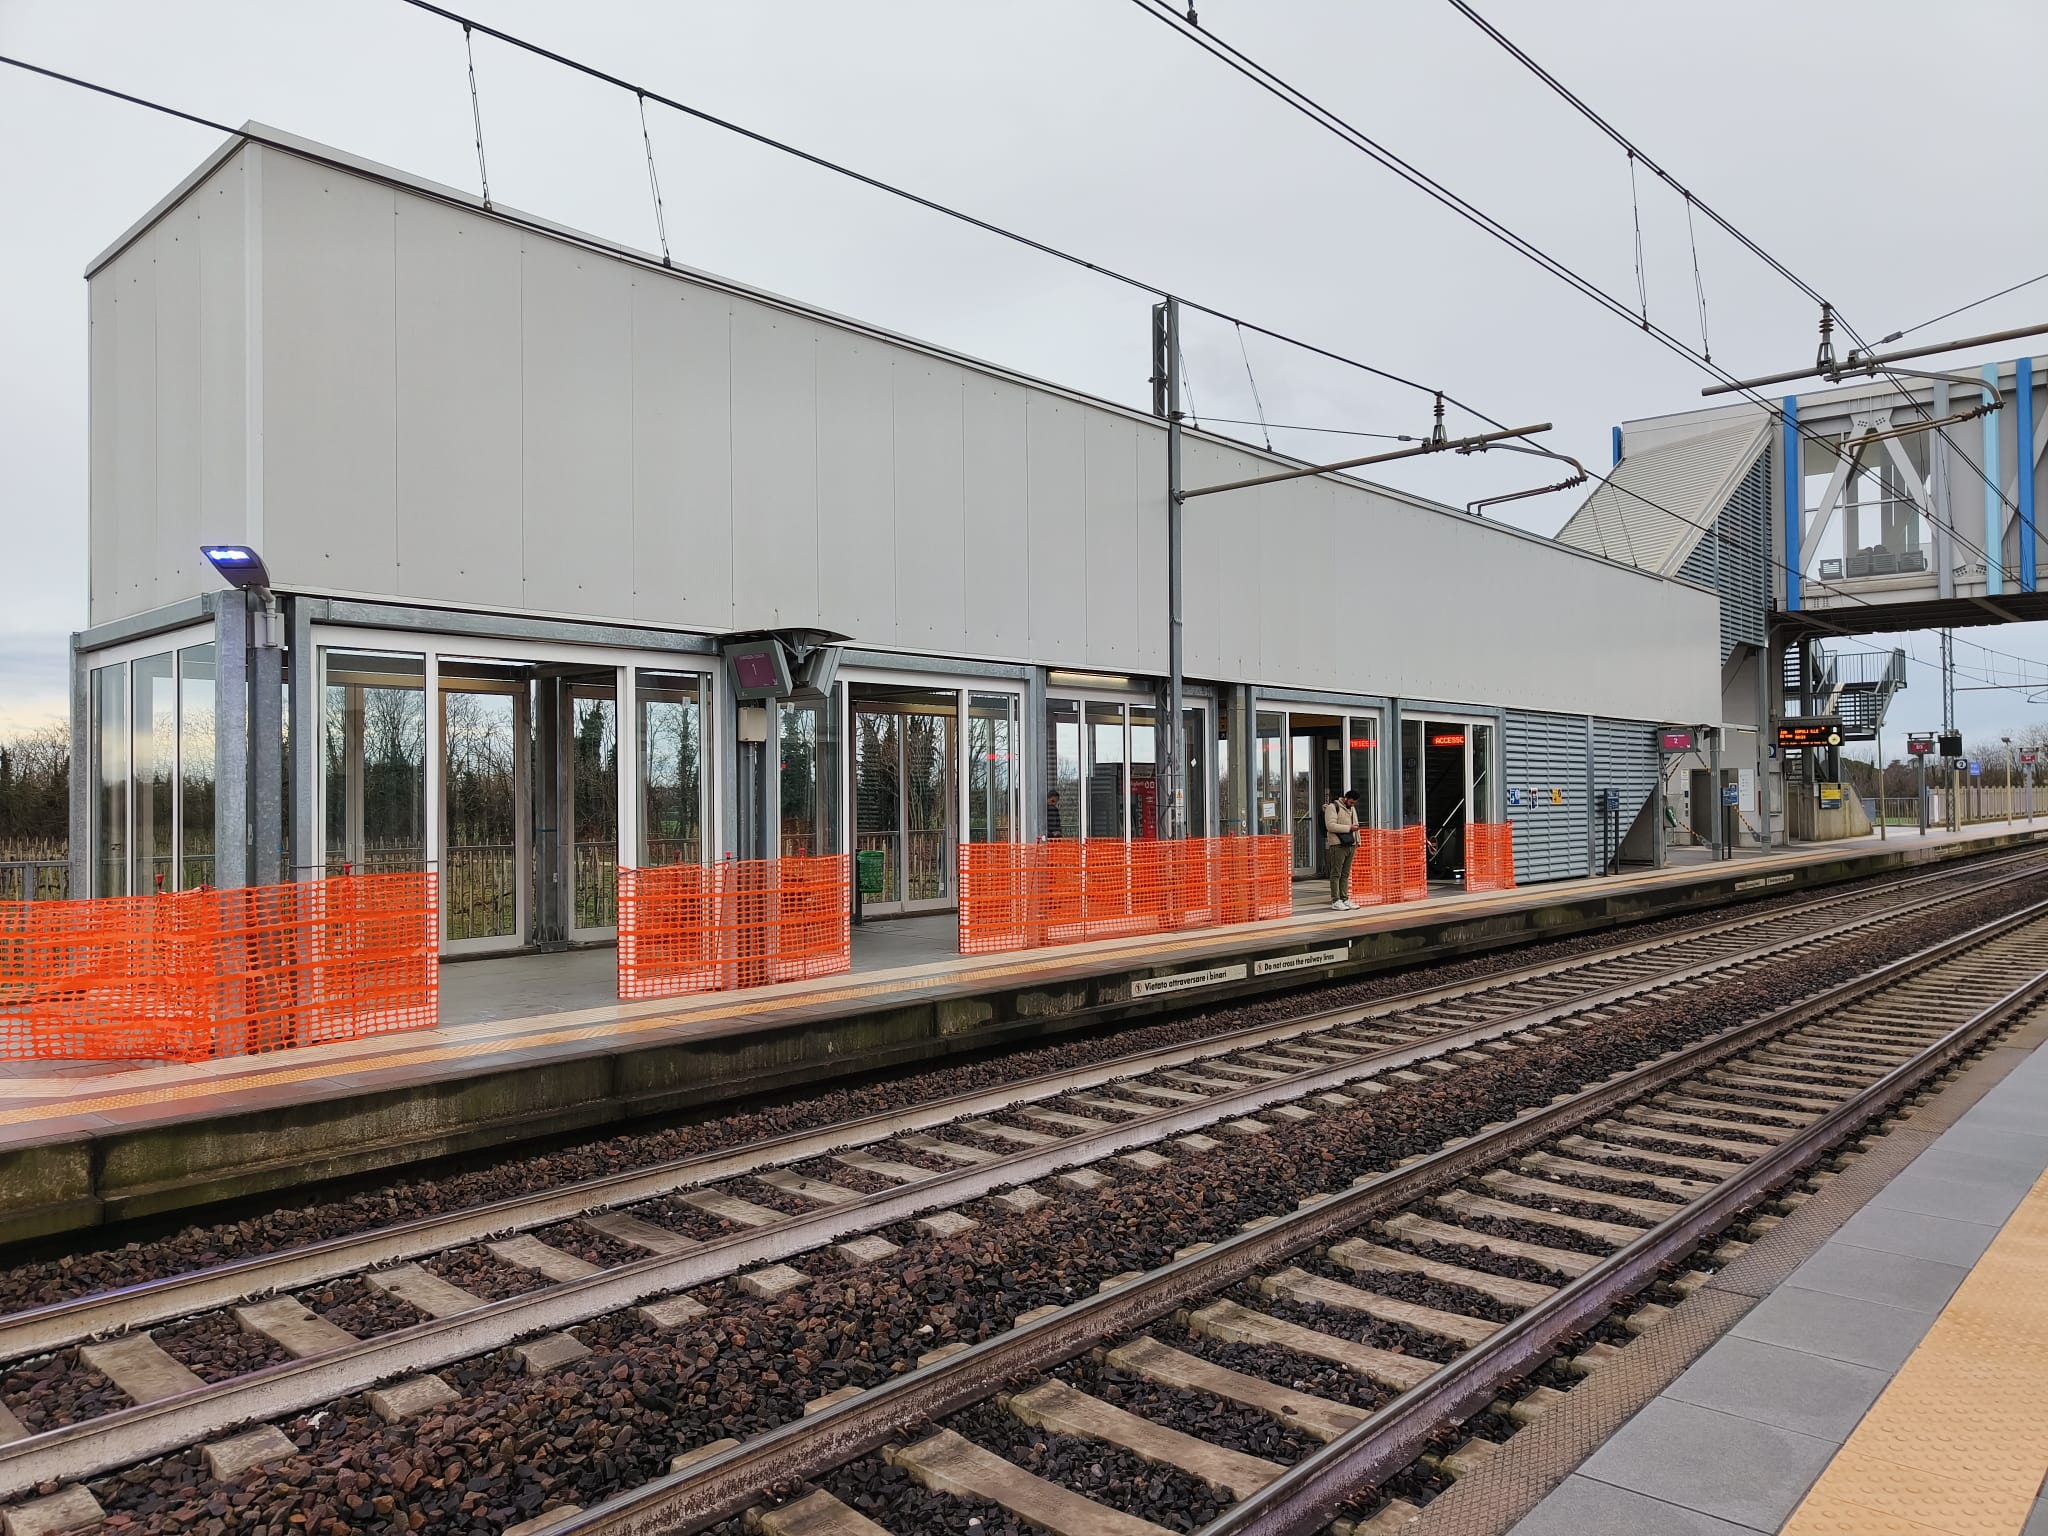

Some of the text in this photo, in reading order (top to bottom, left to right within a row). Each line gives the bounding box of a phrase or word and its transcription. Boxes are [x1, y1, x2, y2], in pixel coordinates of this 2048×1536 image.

[1264, 963, 1272, 971] Do
[1304, 956, 1322, 964] railway
[1323, 953, 1335, 961] lines
[1144, 981, 1168, 991] Vietato
[1168, 975, 1206, 987] attraversare
[1209, 970, 1227, 980] binari
